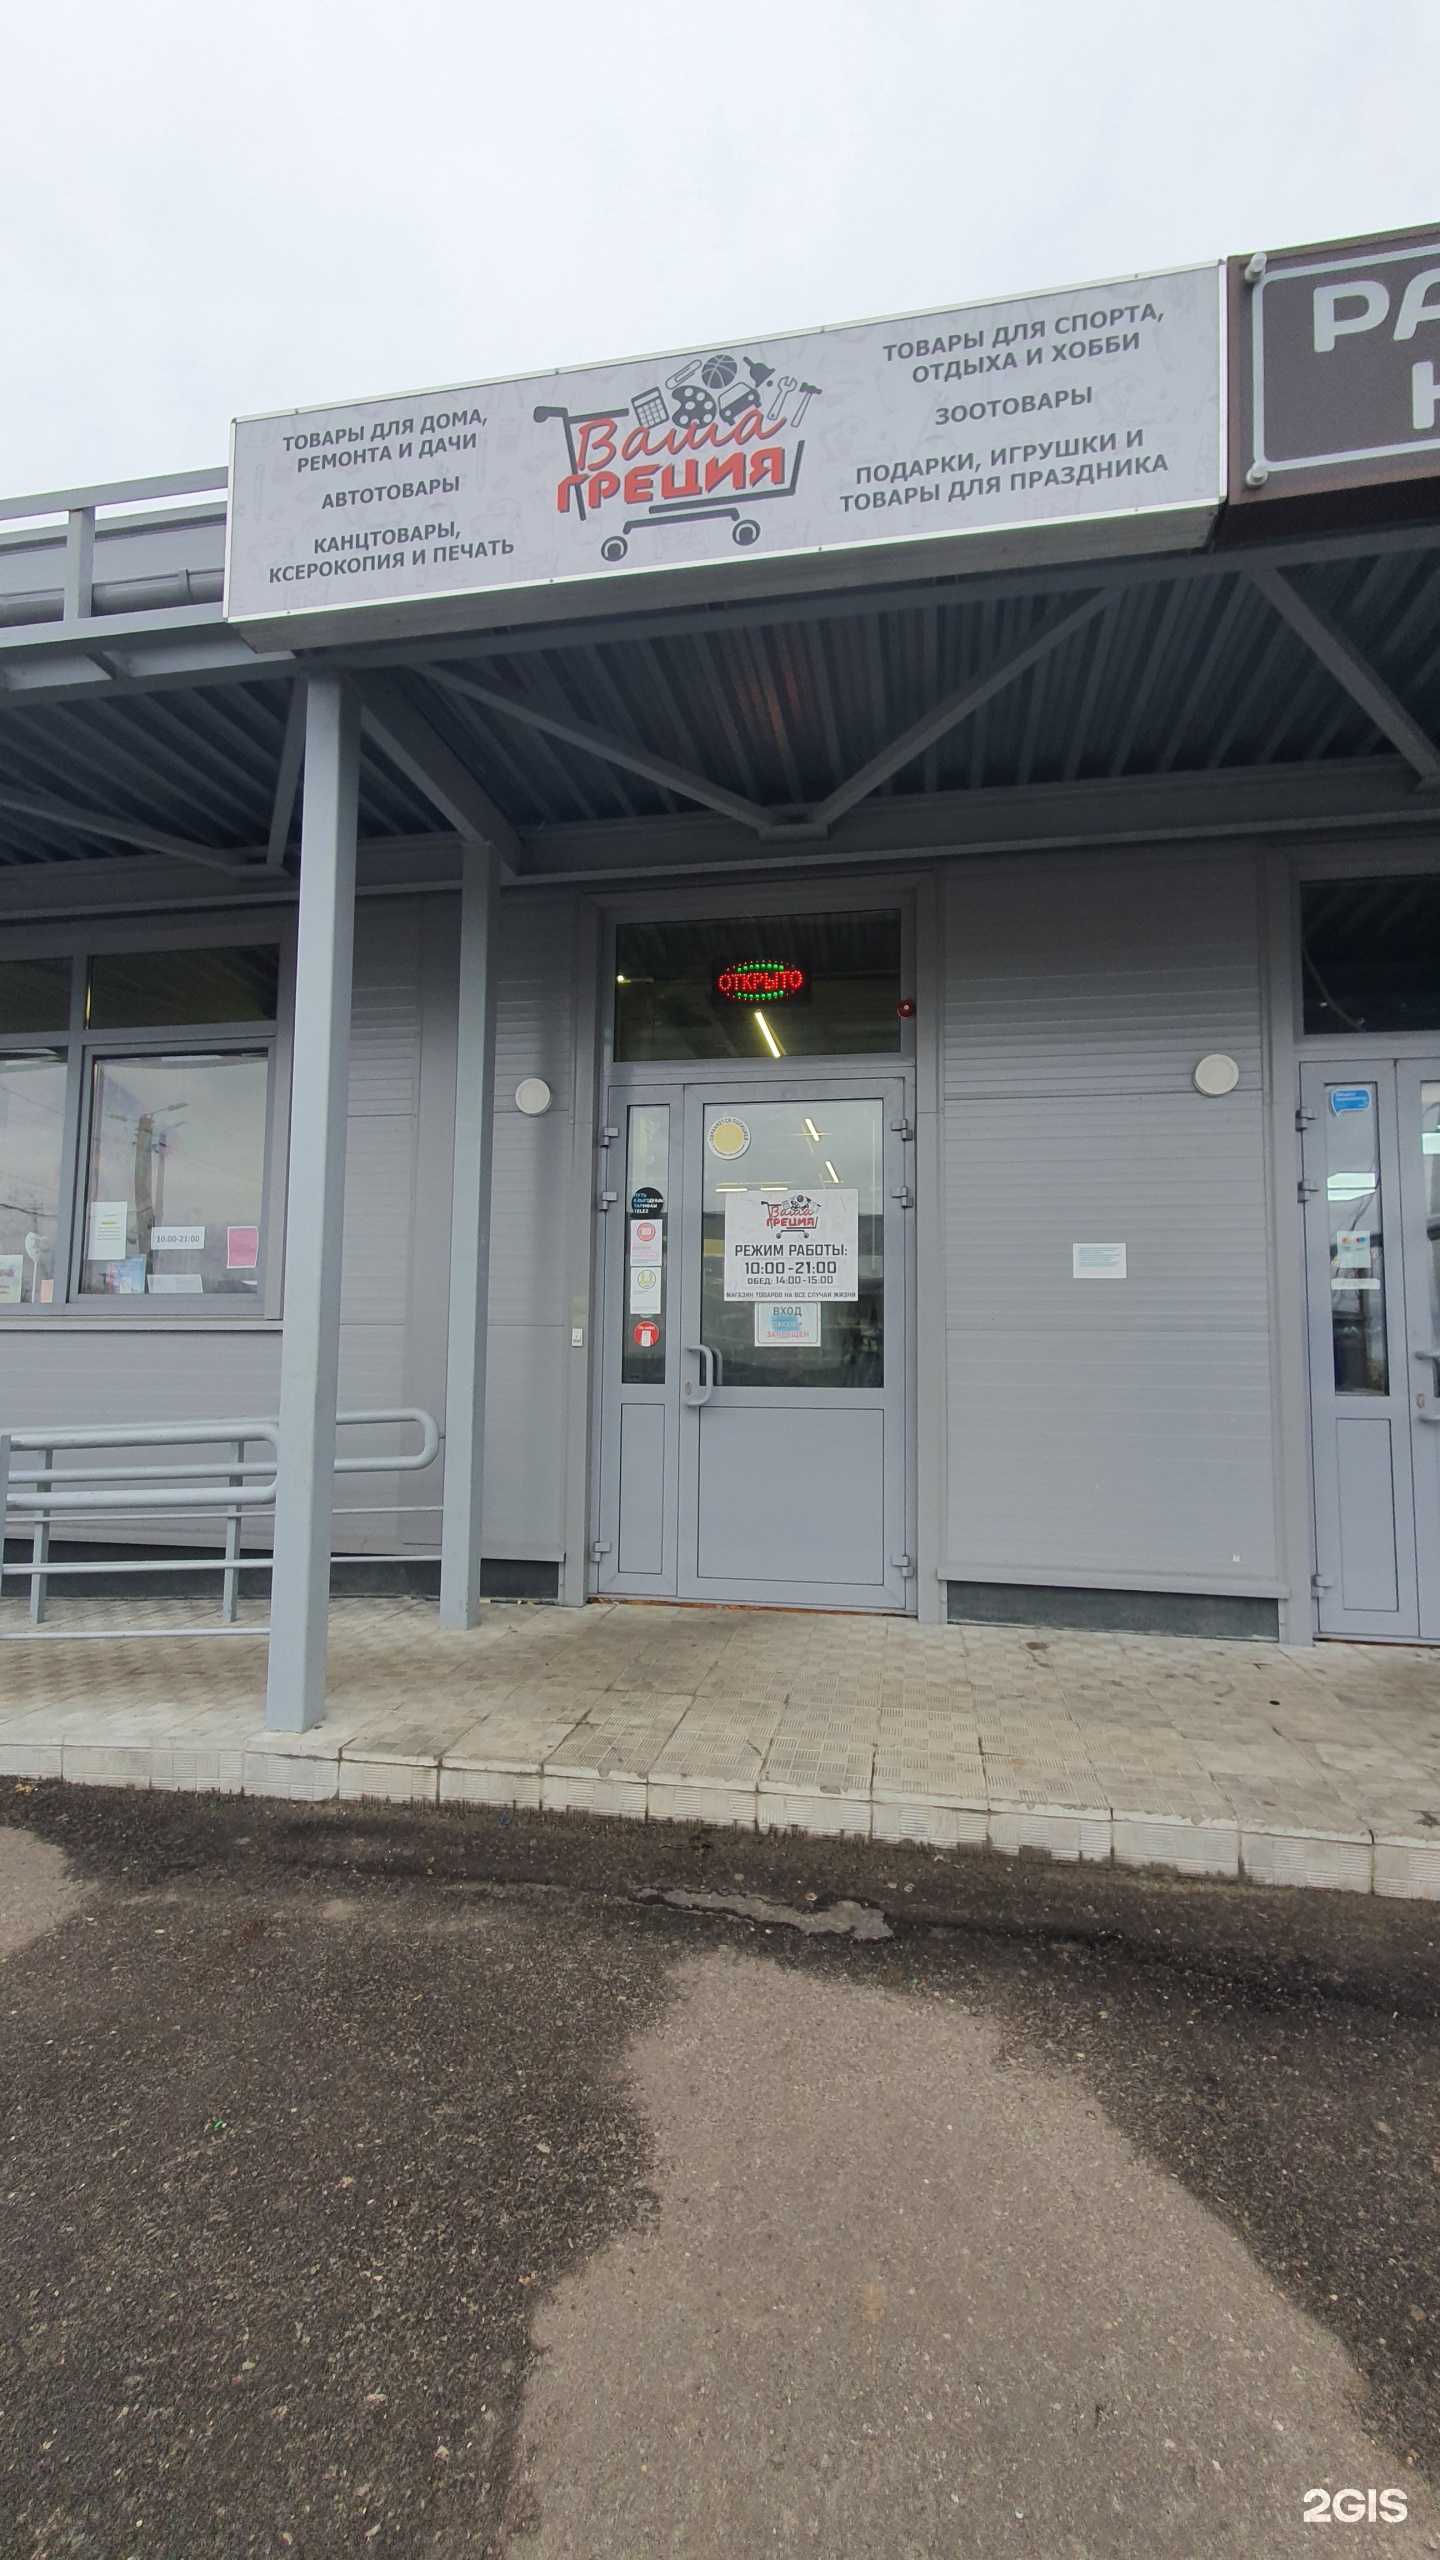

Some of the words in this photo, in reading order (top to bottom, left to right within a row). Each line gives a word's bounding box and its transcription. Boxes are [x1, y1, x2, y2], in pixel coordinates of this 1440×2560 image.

[883, 331, 984, 362] ТОВАРЫ
[991, 320, 1046, 348] ДЛЯ
[1054, 303, 1164, 335] СПОРТА,
[912, 351, 1017, 383] ОТДЫХА
[1026, 348, 1042, 367] И
[1051, 332, 1140, 363] ХОББИ
[935, 386, 1093, 426] ЗООТОВАРЫ
[283, 425, 364, 452] ТОВАРЫ
[370, 418, 414, 441] ДЛЯ
[419, 408, 487, 435] ДОМА,
[576, 408, 787, 471] Ваша
[297, 446, 391, 473] РЕМОНТА
[399, 443, 412, 459] И
[418, 433, 477, 458] ДАЧИ
[856, 452, 981, 485] ПОДАРКИ,
[990, 432, 1116, 467] ИГРУШКИ
[1126, 428, 1144, 448] И
[321, 476, 460, 510] АВТОТОВАРЫ
[557, 447, 785, 513] ГРЕЦИЯ
[840, 483, 940, 513] ТОВАРЫ
[948, 475, 1001, 502] ДЛЯ
[1010, 453, 1169, 491] ПРАЗДНИКА
[314, 521, 461, 555] КАНЦТОВАРЫ,
[269, 551, 404, 584] КСЕРОКОПИЯ
[412, 549, 426, 566] И
[433, 538, 515, 563] ПЕЧАТЬ
[719, 970, 802, 990] ОТКРЫТО
[766, 1217, 815, 1227] ГРЕЦИЯ
[735, 1244, 784, 1257] РЕЖИМ
[788, 1243, 848, 1257] РАБОТЫ:
[773, 1306, 802, 1317] ВХОД
